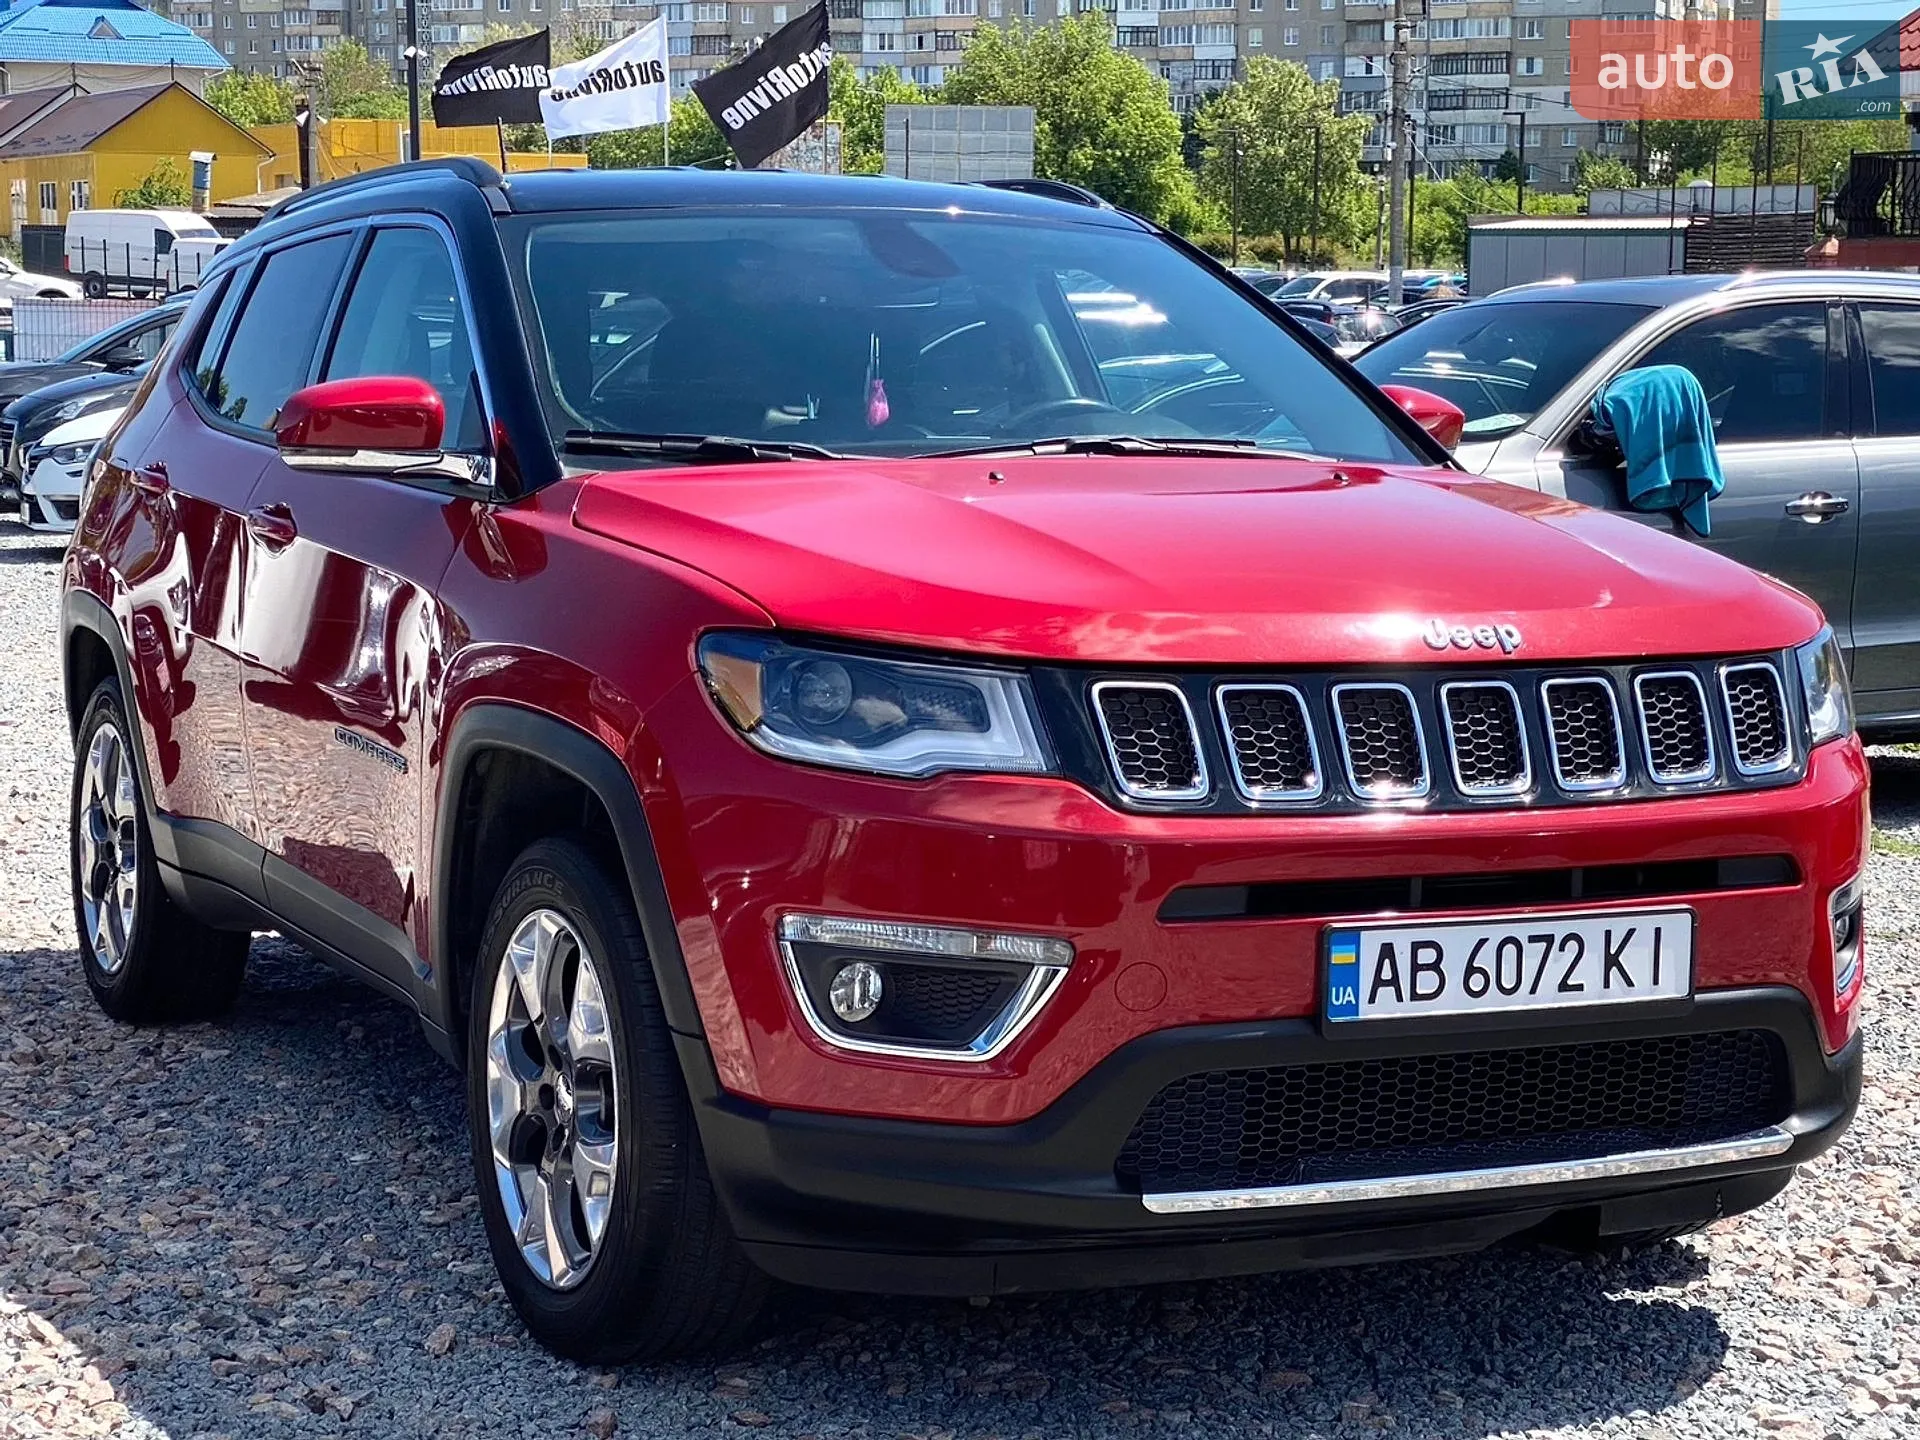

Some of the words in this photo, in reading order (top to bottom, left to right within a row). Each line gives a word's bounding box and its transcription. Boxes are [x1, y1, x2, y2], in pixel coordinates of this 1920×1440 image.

[1422, 618, 1522, 655] Jeep
[1367, 940, 1446, 1005] AB
[1462, 931, 1585, 999] 6072
[1602, 926, 1662, 990] KI
[1331, 986, 1356, 1006] UA
